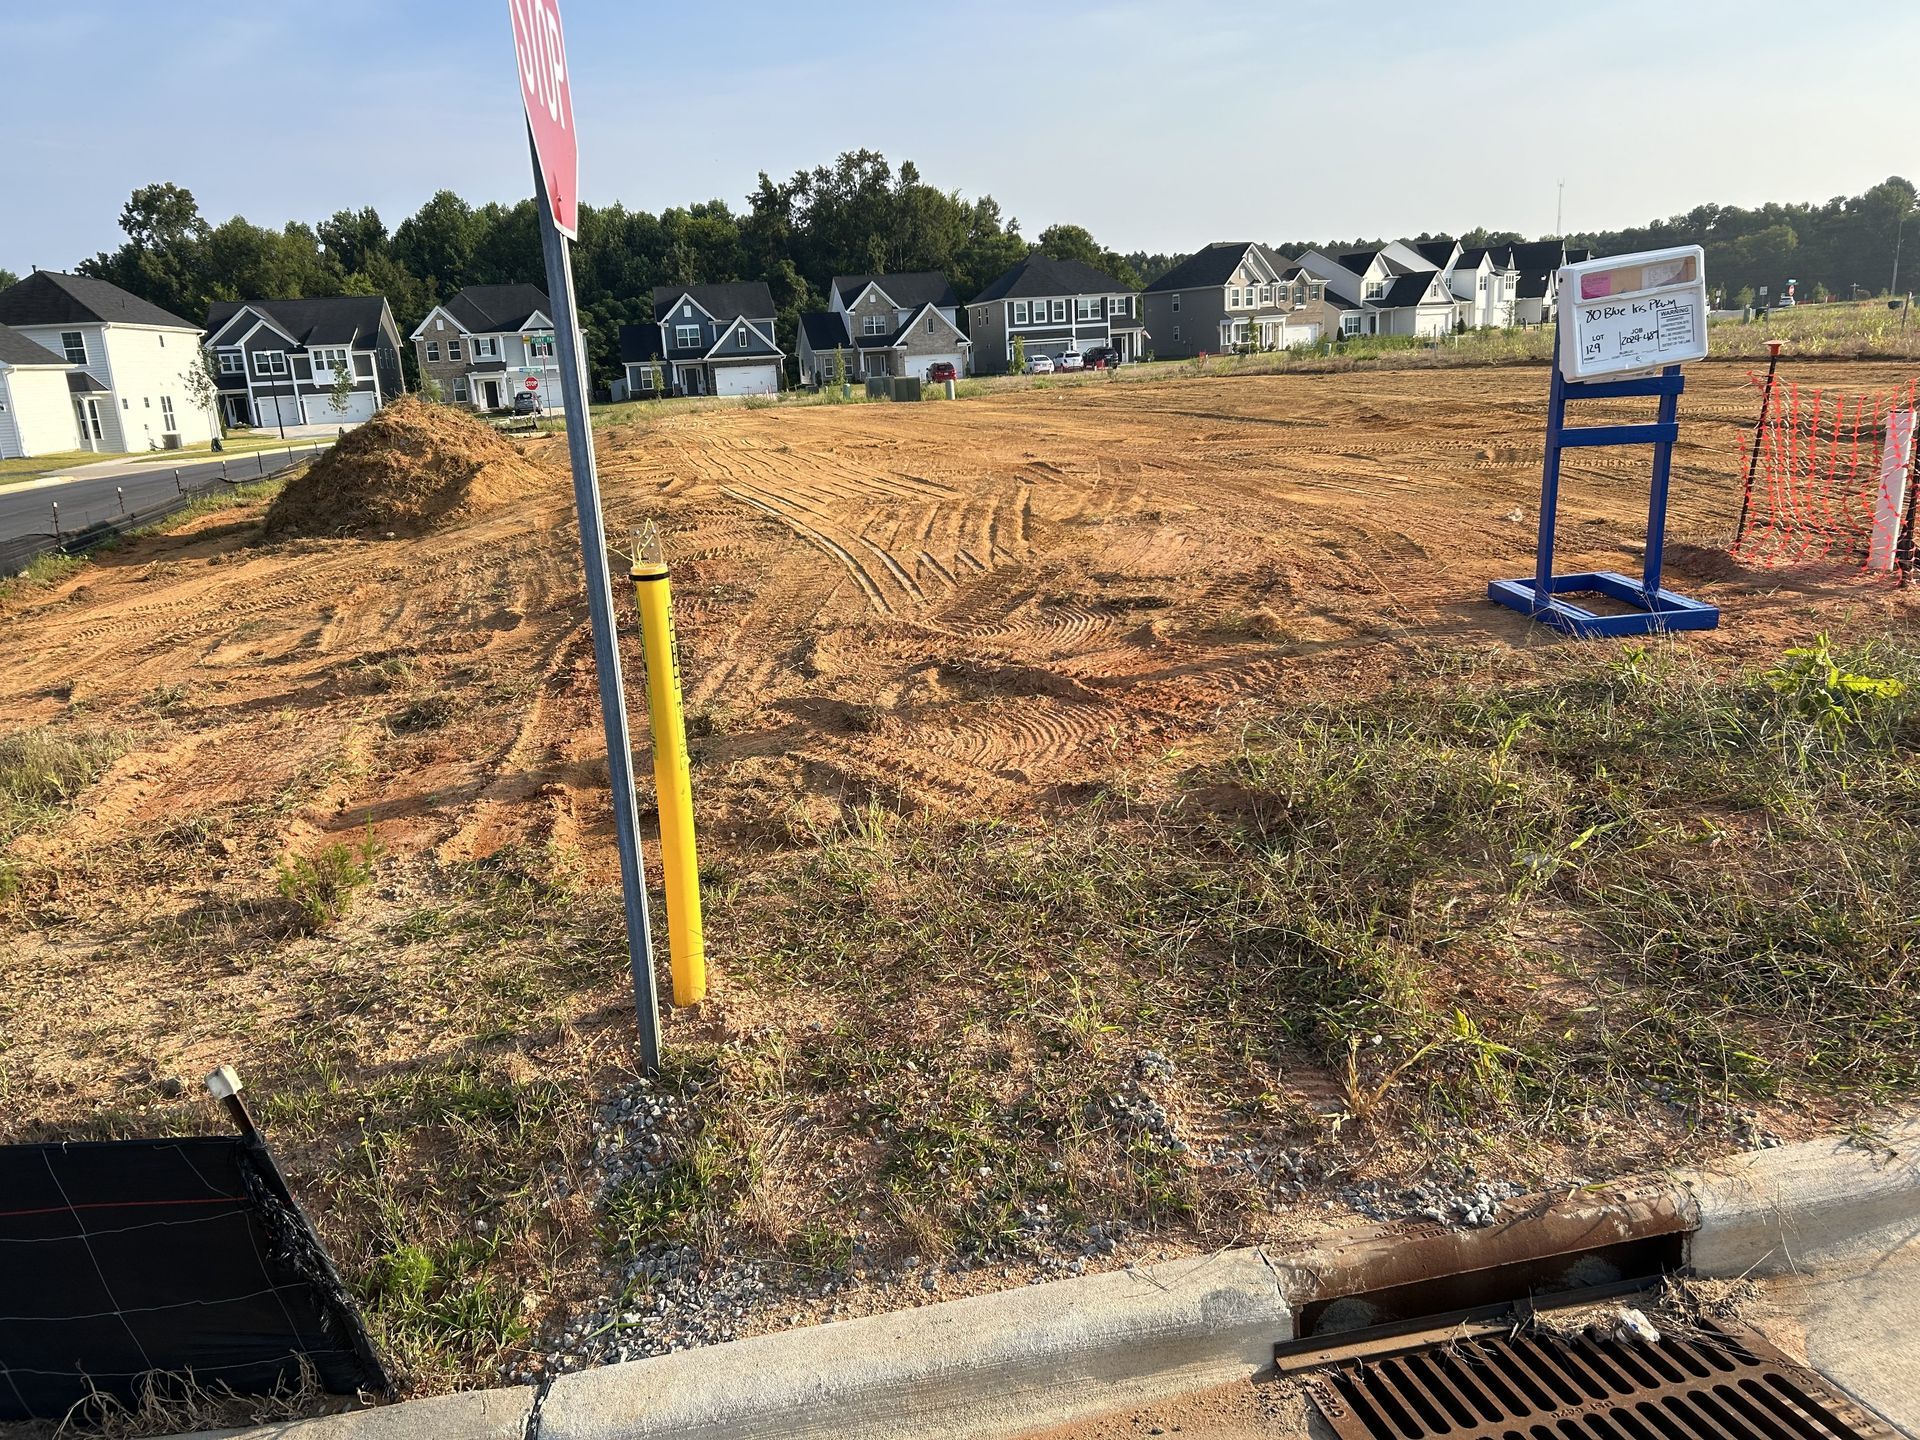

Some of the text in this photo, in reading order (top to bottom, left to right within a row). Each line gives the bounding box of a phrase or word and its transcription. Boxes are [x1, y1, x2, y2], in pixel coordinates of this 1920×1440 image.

[1585, 310, 1601, 324] 80
[1603, 306, 1626, 320] Blue
[1632, 303, 1647, 314] Iris
[1660, 306, 1689, 317] WARNING
[1632, 327, 1644, 335] JOB
[1592, 334, 1605, 342] LOT
[1585, 342, 1601, 355] 129
